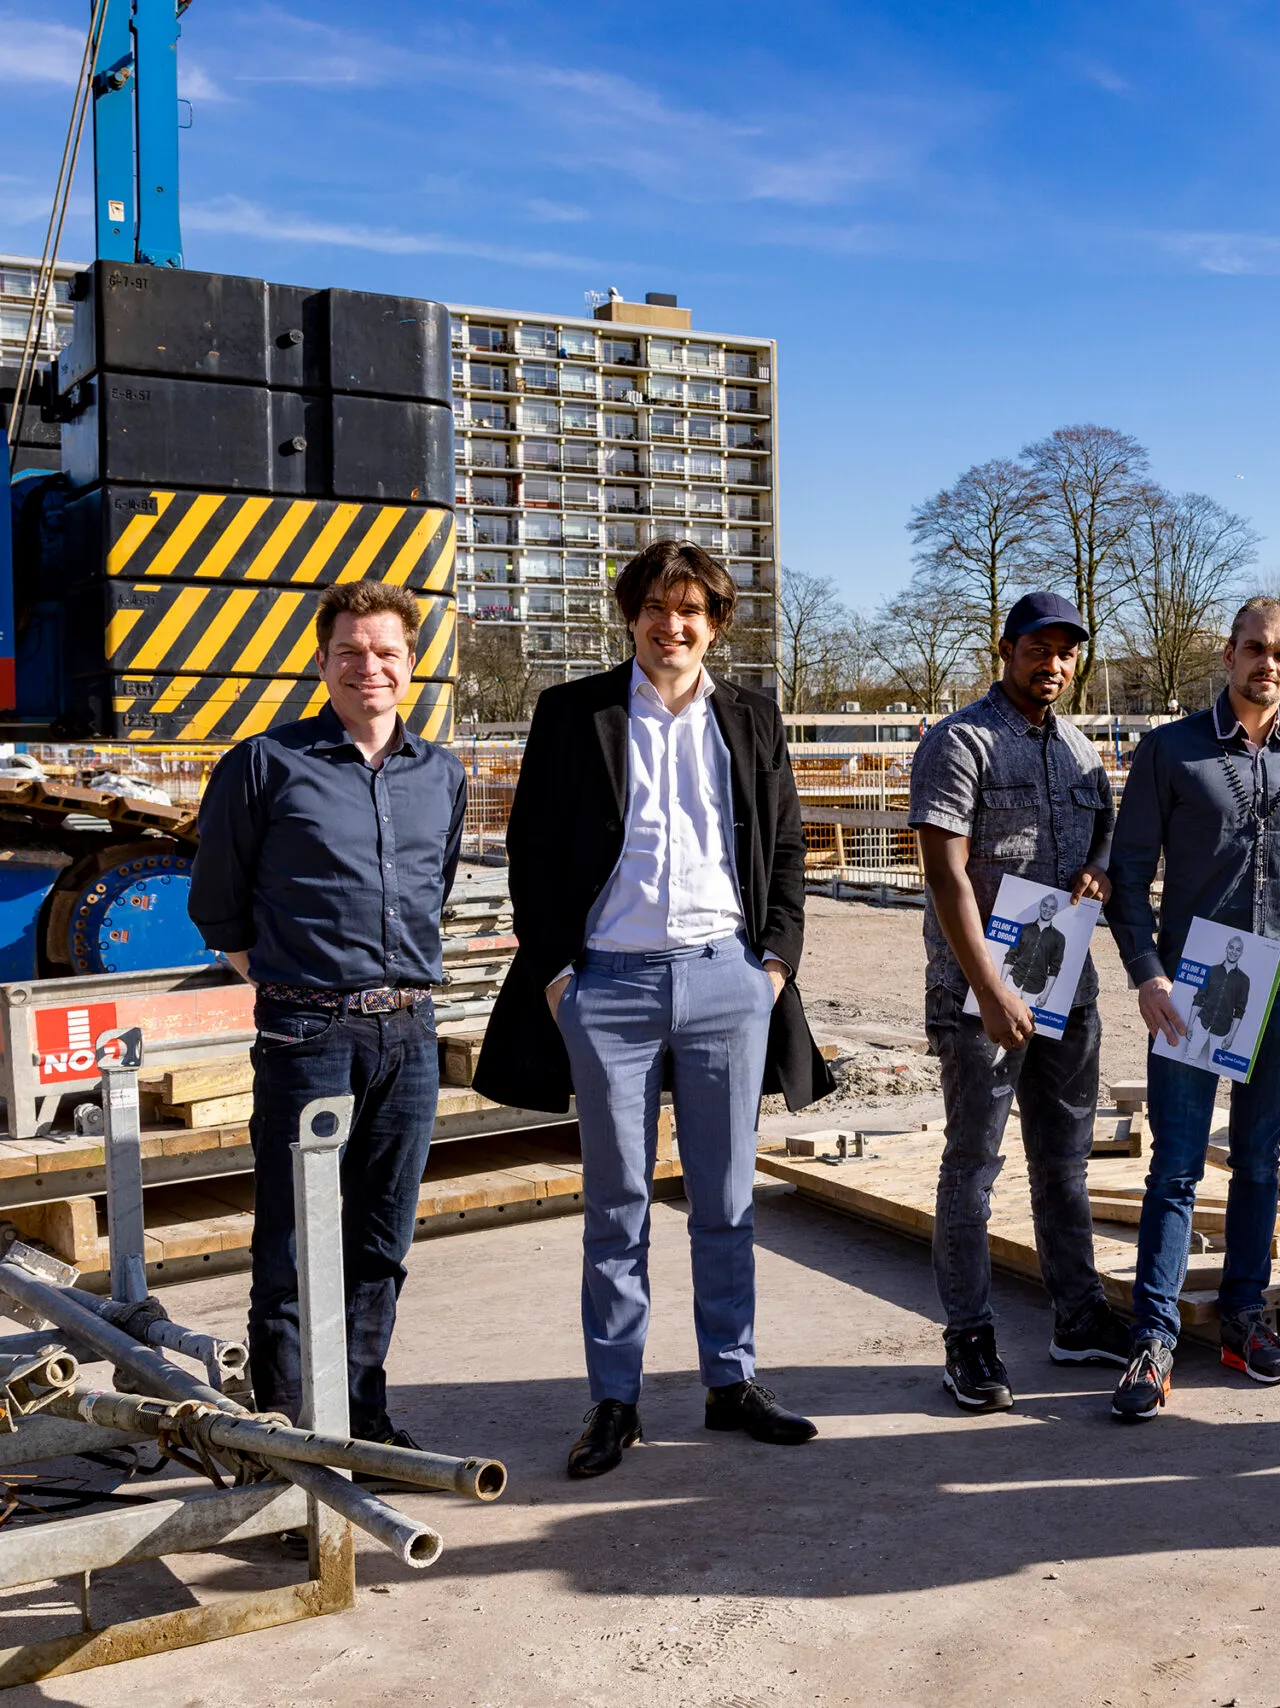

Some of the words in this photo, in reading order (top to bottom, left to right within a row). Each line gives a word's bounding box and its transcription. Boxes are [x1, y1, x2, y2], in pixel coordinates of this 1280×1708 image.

[992, 919, 1012, 932] GELOOF
[1011, 926, 1019, 934] IN
[989, 929, 997, 937] JE
[997, 931, 1017, 943] DROOM
[1181, 961, 1201, 974] GELOOF
[1200, 967, 1207, 976] IN
[1178, 970, 1186, 979] JE
[1186, 973, 1204, 985] DROOM
[1048, 1015, 1063, 1024] College
[44, 1047, 116, 1074] NO
